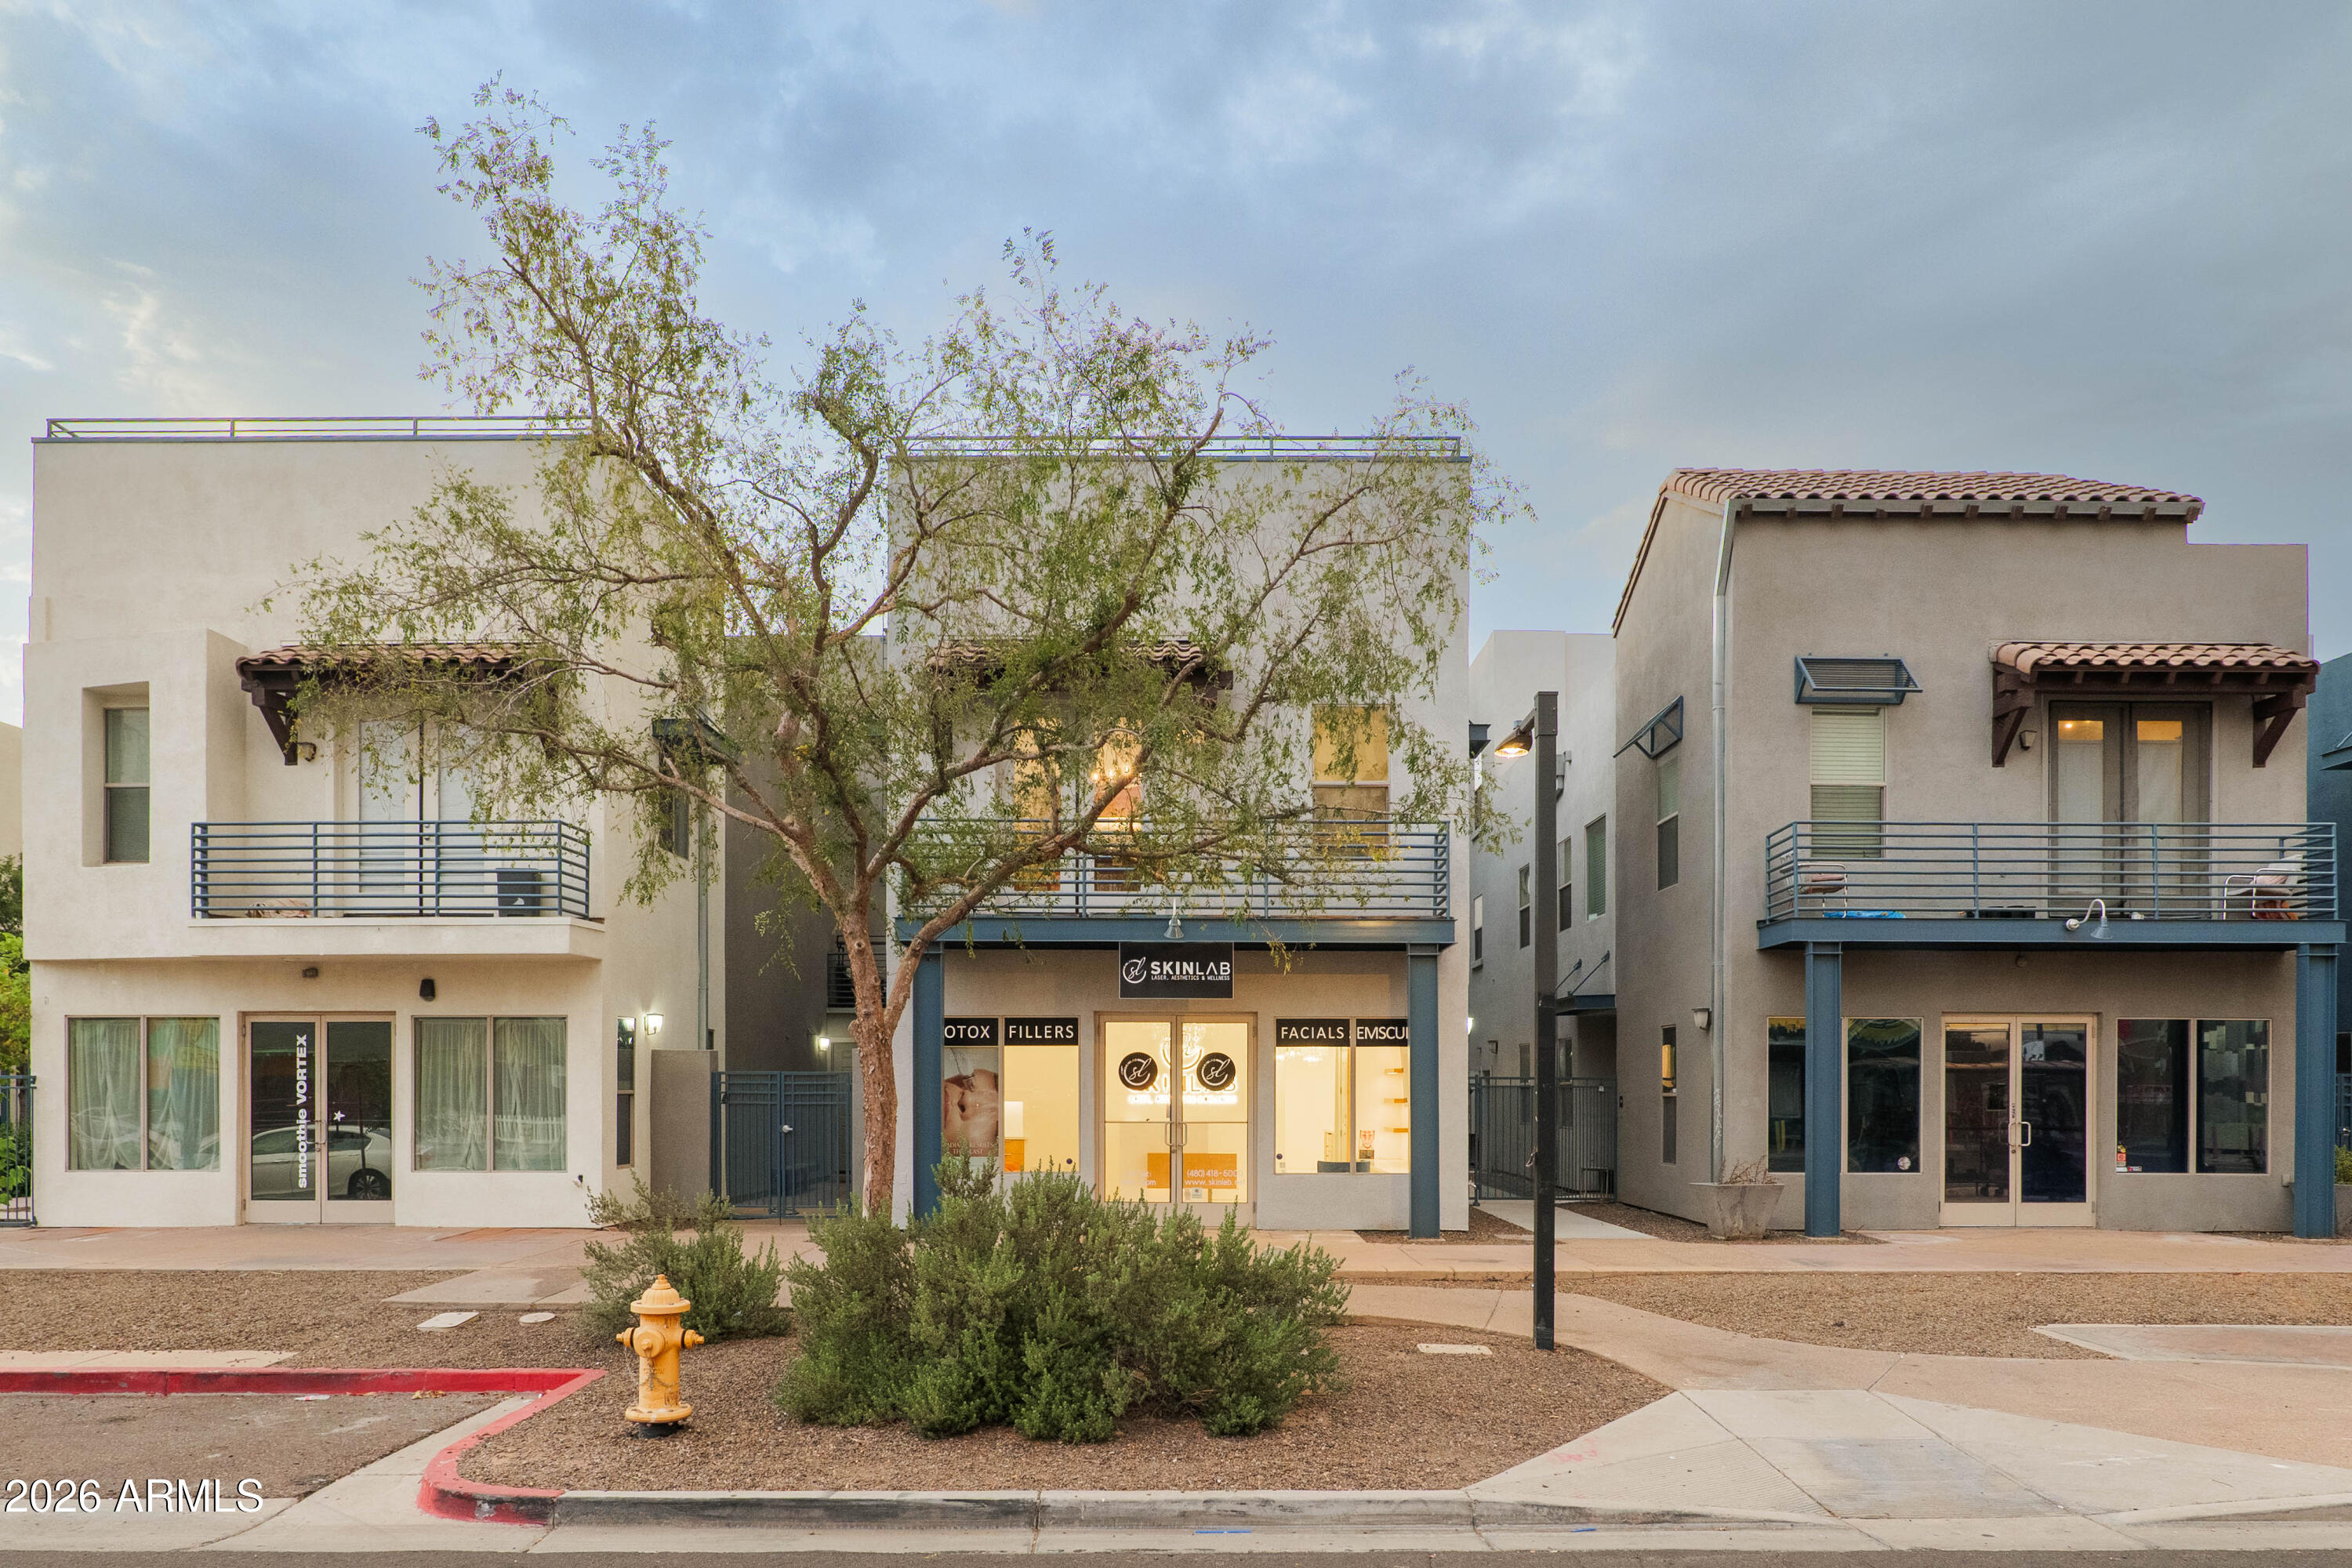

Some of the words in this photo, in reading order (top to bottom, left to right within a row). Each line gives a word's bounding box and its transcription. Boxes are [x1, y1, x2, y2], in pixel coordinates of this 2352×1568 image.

[1150, 961, 1231, 975] SKINLAB
[944, 1025, 990, 1039] OTOX
[1009, 1025, 1074, 1039] FILLERS
[1281, 1026, 1345, 1040] FACIALS
[296, 1034, 308, 1105] VORTEX
[296, 1109, 308, 1189] smoothie
